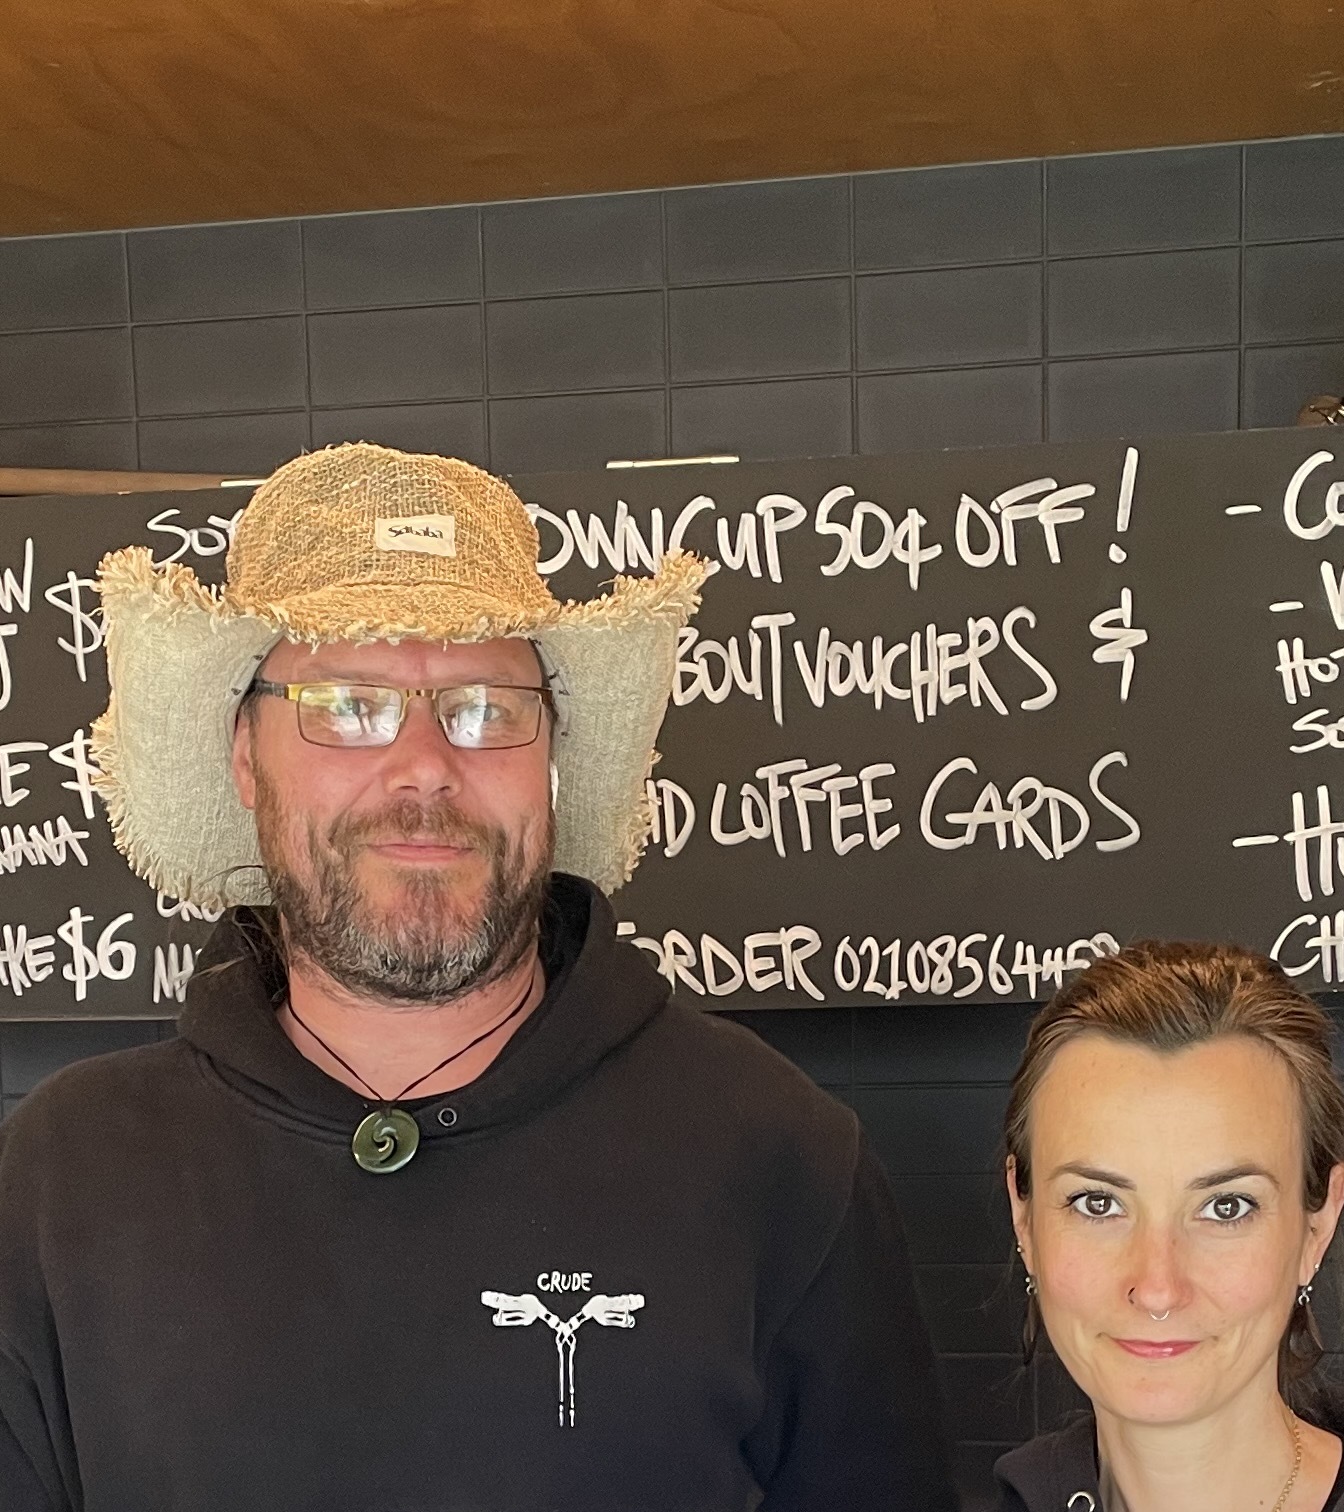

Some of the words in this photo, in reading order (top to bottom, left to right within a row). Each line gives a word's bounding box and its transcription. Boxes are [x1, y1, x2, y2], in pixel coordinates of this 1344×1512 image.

[671, 610, 796, 728] BOUT
[794, 605, 1060, 725] VOUCHERS
[1088, 586, 1149, 703] &
[55, 906, 138, 1003] $6
[536, 1270, 594, 1294] CRUDE
